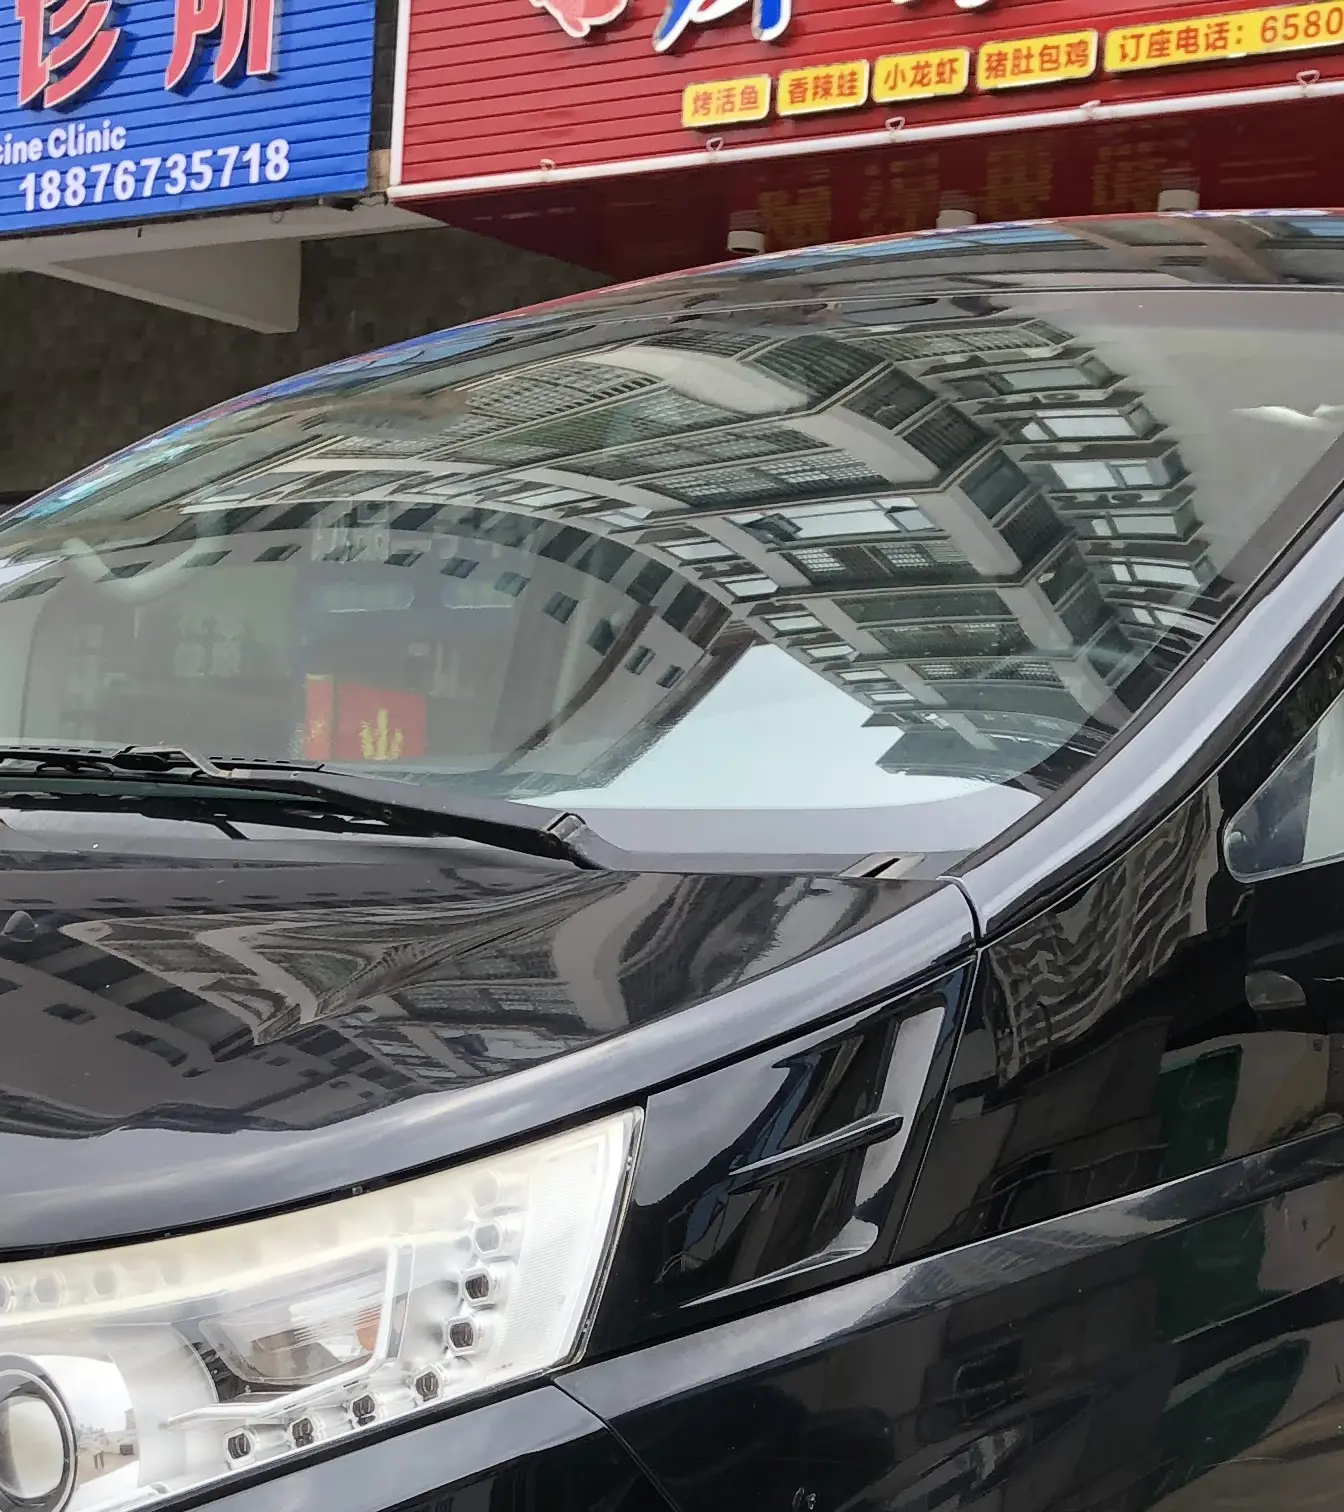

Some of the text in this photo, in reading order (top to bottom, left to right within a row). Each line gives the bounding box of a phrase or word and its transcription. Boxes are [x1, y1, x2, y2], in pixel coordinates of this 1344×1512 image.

[884, 48, 960, 91] 小龙虾
[985, 38, 1090, 79] 猪肚包鸡
[692, 86, 760, 117] 烤活鱼
[788, 71, 860, 104] 香辣蛙
[47, 120, 127, 158] Clinic
[19, 139, 291, 212] 18876735718
